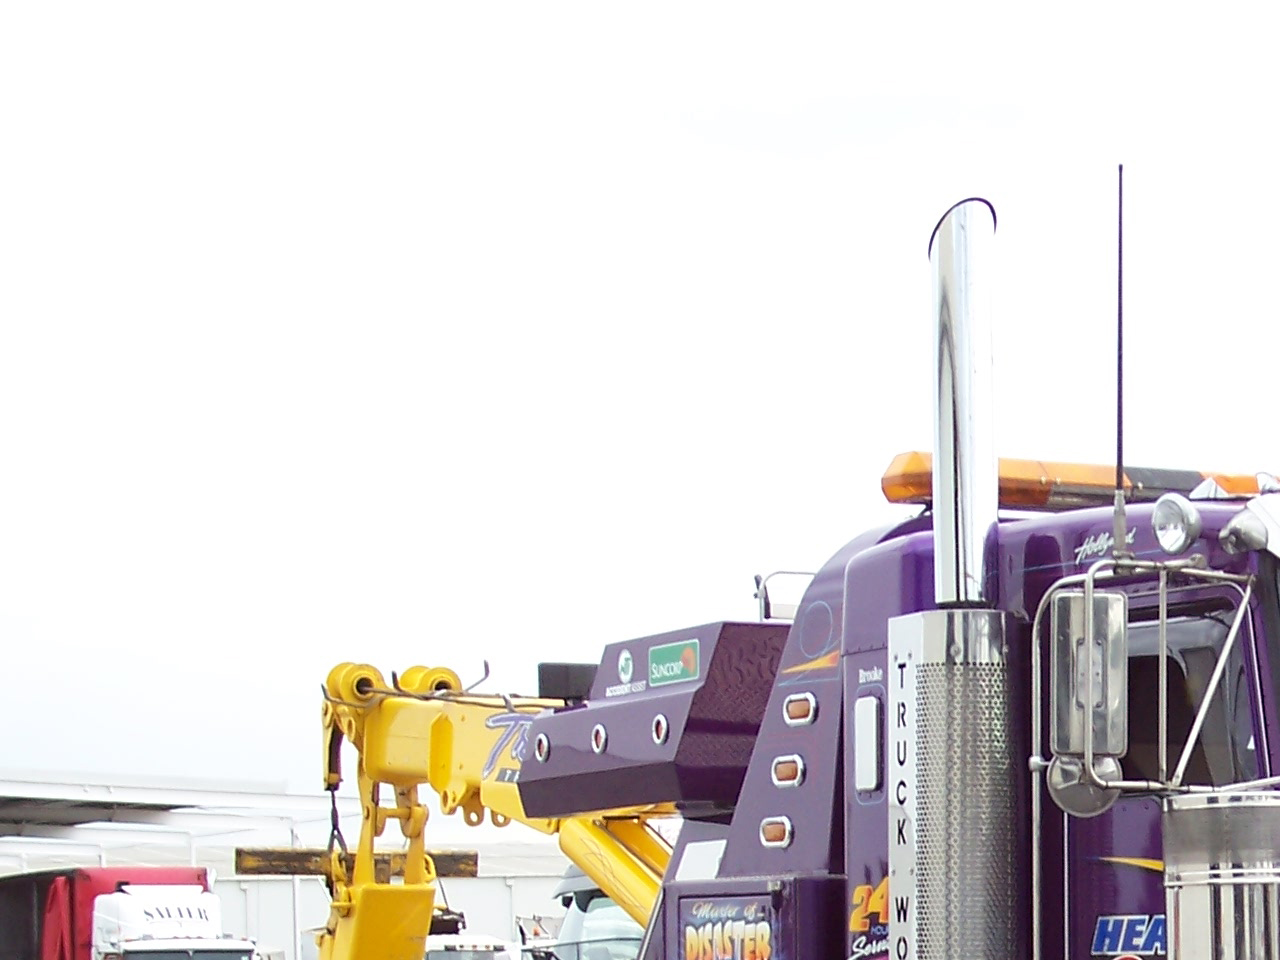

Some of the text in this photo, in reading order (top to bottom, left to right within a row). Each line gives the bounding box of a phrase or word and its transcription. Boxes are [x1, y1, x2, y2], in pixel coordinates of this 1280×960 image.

[1074, 526, 1136, 565] Hollyd
[896, 663, 907, 846] TRUCK
[692, 901, 740, 919] Master
[849, 876, 889, 933] 24
[870, 925, 889, 936] HOU
[1091, 915, 1166, 956] HEA
